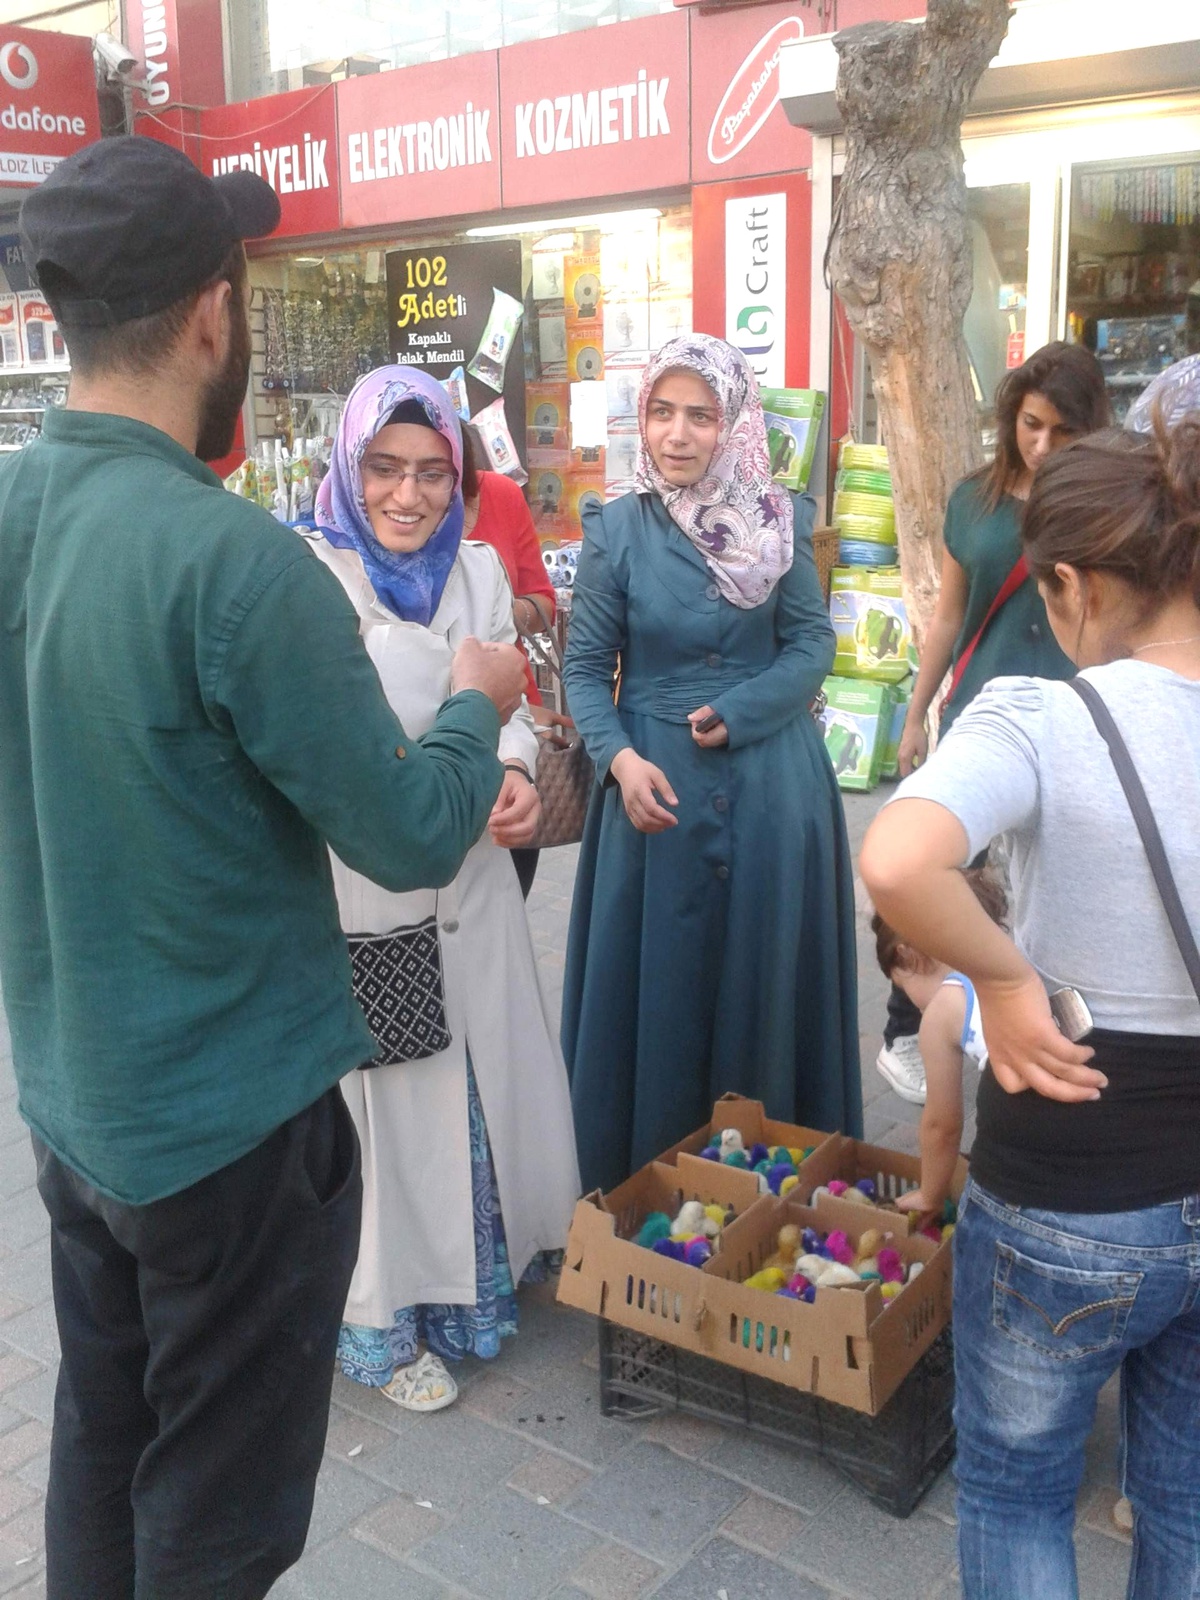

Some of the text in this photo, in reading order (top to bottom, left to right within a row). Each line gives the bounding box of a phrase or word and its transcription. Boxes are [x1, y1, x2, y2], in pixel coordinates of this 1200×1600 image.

[1, 104, 86, 135] dafone
[349, 101, 492, 184] ELEKTRONİK
[515, 69, 671, 158] KOZMETİK
[746, 206, 769, 295] Craft
[406, 256, 448, 288] 102
[397, 291, 467, 328] Adetli
[408, 331, 452, 347] Kapaklı
[397, 350, 465, 365] Islak Mendil
